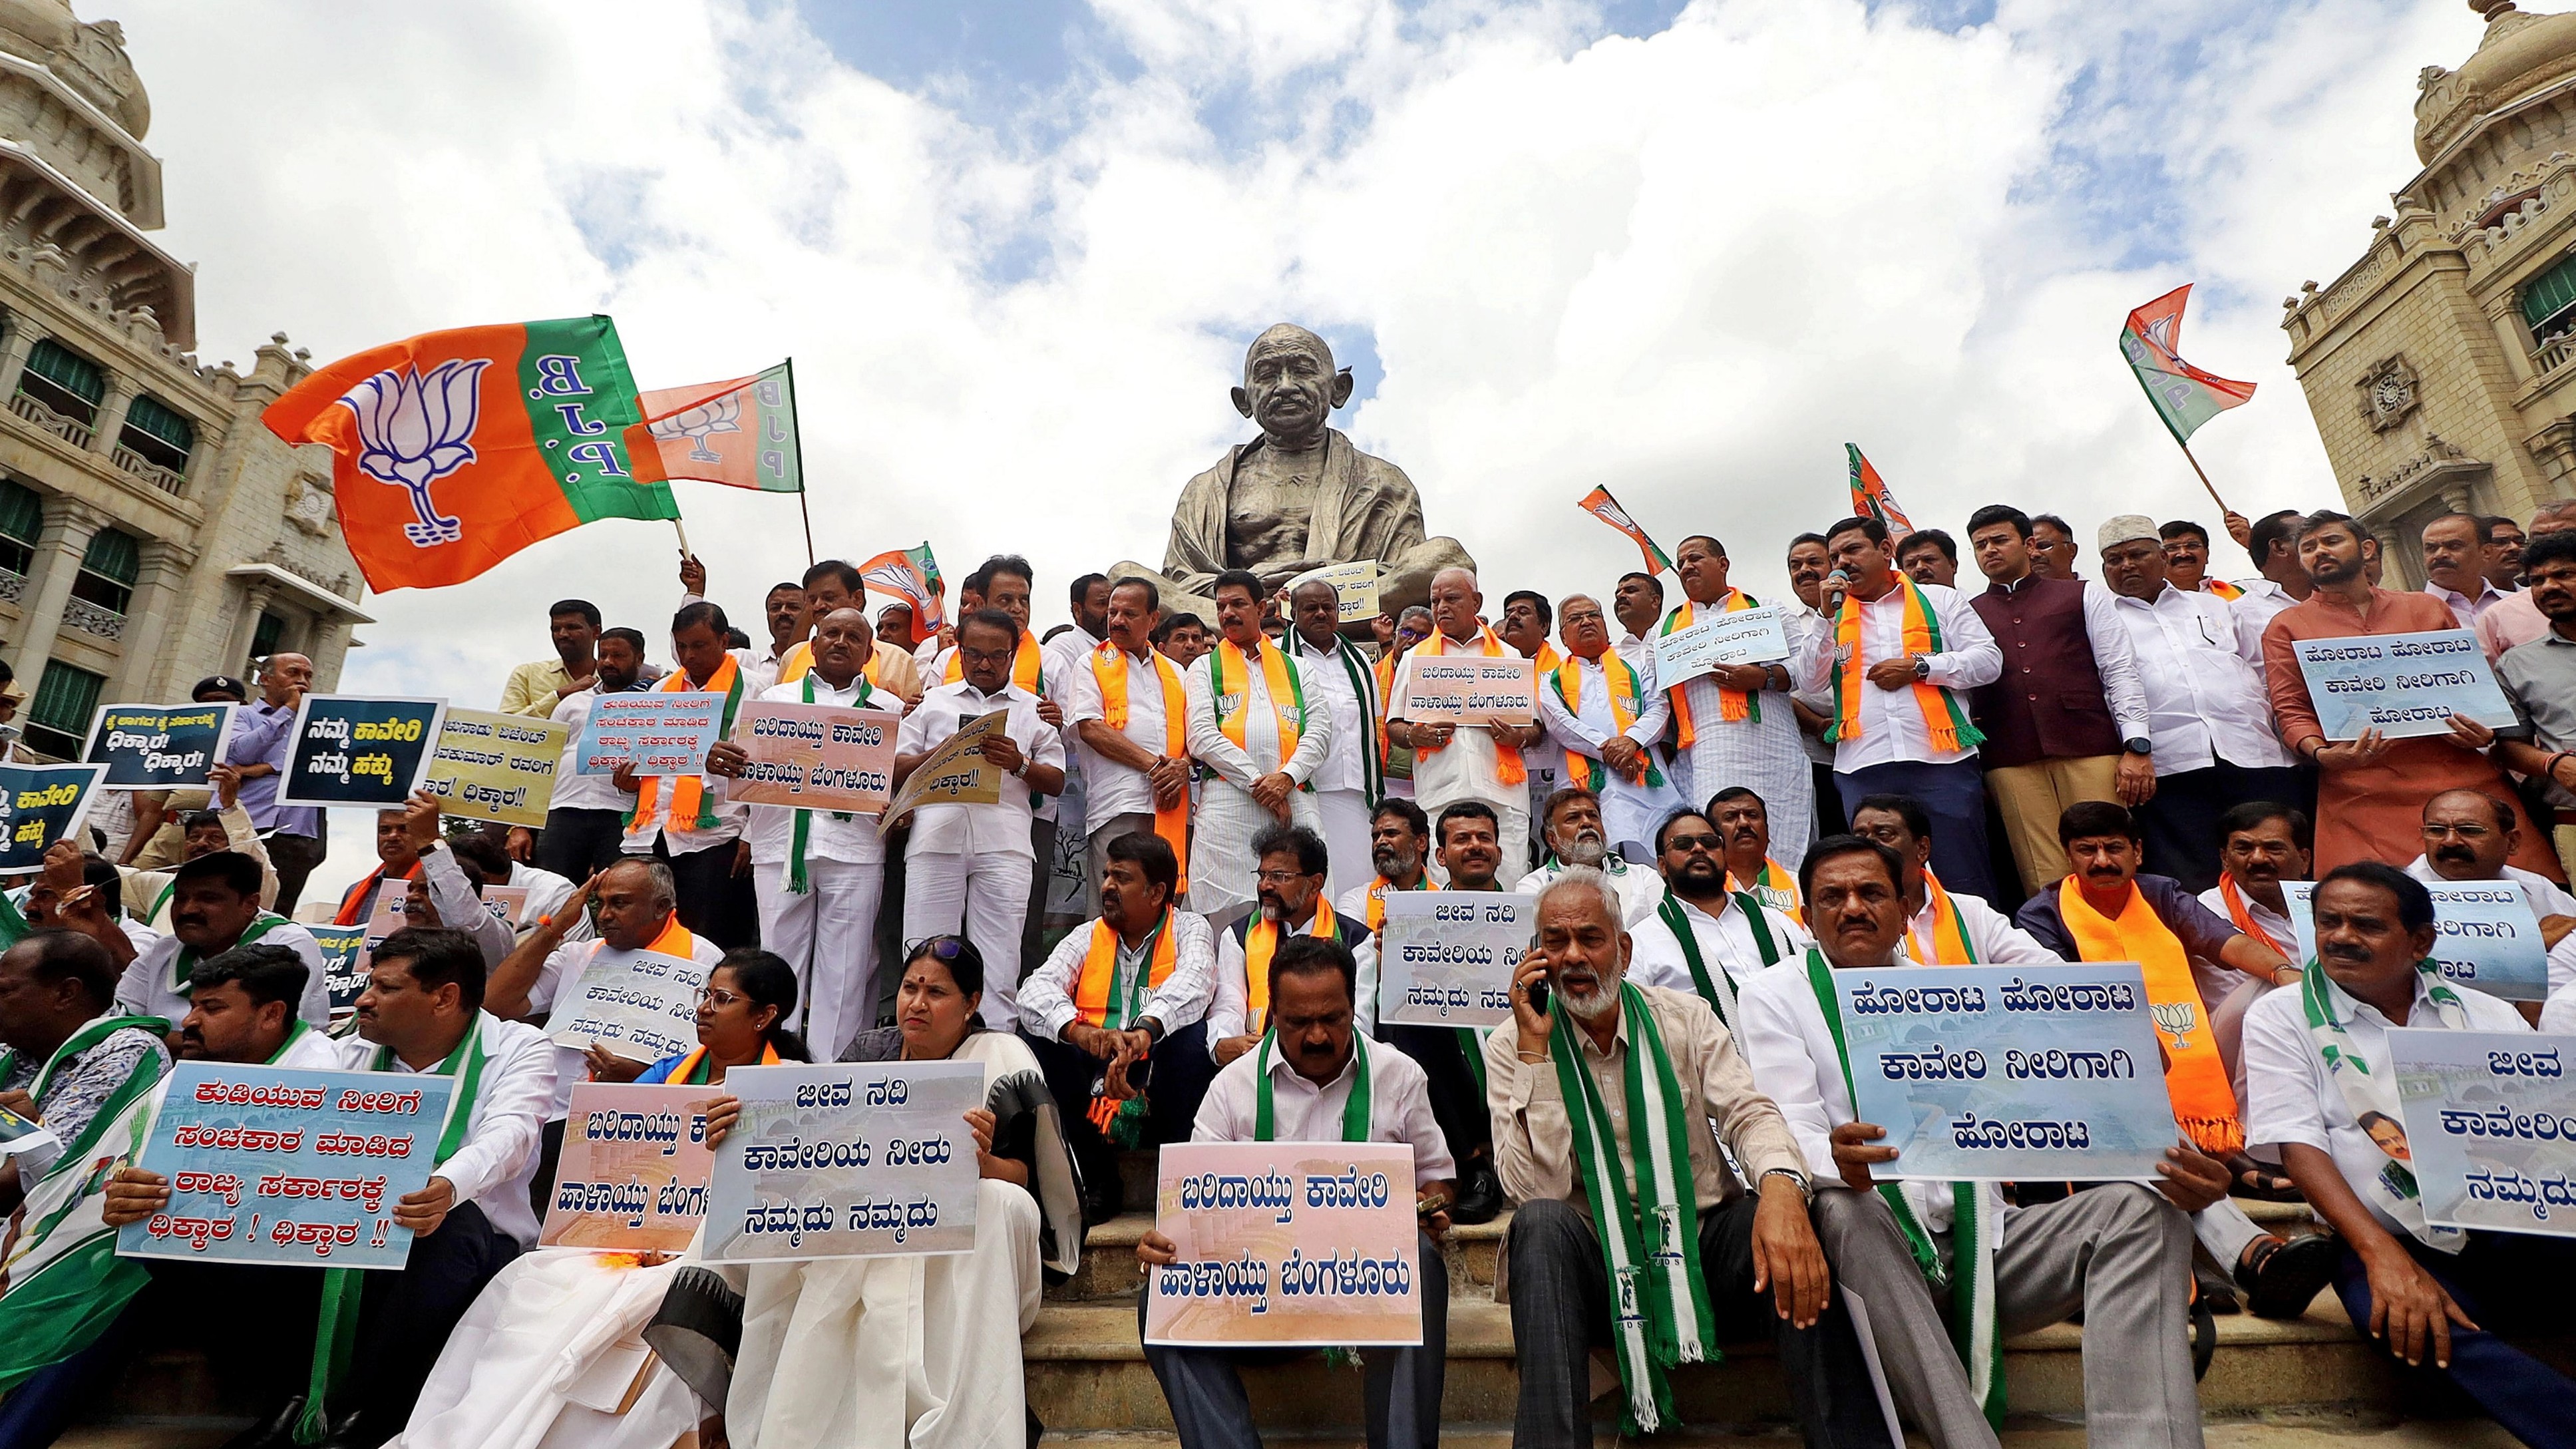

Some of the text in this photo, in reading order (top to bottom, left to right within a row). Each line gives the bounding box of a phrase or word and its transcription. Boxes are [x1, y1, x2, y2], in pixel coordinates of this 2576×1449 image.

[1339, 598, 1365, 616] ಕ್ಕಾರ!!
[1660, 610, 1773, 650] ಹೋರಾಟ ಹೋರಾಟ
[1666, 628, 1770, 662] ಕಾವೇರಿ ನೀರಿಗಾಗಿ
[2304, 637, 2473, 663] ಹೋರಾಟ ಹೋರಾಟ
[1421, 664, 1522, 684] ಬರಿದಾಯ್ತು ಕಾವೇರಿ
[2325, 668, 2477, 694] ಕಾವೇರಿ ನೀರಿಗಾಗಿ
[602, 698, 711, 710] ಕುಡಿಯುವ ನೀರಿಗೆ
[1410, 692, 1529, 716] ಹಾಳಾಯ್ತು ಬೆಂಗಳೂರು
[2370, 706, 2453, 725] ಹೋರಾಟ
[307, 717, 423, 749] ನಮ್ಮ ಕಾವೇರಿ
[498, 726, 548, 744] ಏಜೆಂಟ್
[595, 716, 710, 727] ಸಂಚಕಾರ ಮಾಡಿದ
[754, 716, 883, 749] ಬರಿದಾಯ್ತು ಕಾವೇರಿ
[105, 731, 171, 756] ಧಿಕ್ಕಾರ!
[598, 735, 699, 751] ರಾಜ್ಯ ಸರ್ಕಾರಕ್ಕೆ
[143, 750, 206, 775] ಧಿಕ್ಕಾರ!
[307, 751, 393, 786] ನಮ್ಮ ಹಕ್ಕು
[510, 756, 554, 775] ರವರಿಗೆ
[647, 755, 689, 772] ಧಿಕ್ಕಾರ
[811, 762, 888, 792] ಬೆಂಗಳೂರು
[16, 783, 79, 809] ಕಾವೇರಿ
[462, 782, 527, 813] ಧಿಕ್ಕಾರ!!
[15, 819, 46, 849] ಹಕ್ಕು
[1435, 900, 1516, 923] ಜೀವ ನದಿ
[1401, 940, 1493, 965] ಕಾವೇರಿಯ
[632, 959, 703, 988] ಜೀವ ನದಿ
[586, 985, 664, 1012] ಕಾವೇರಿಯ
[1406, 981, 1471, 1017] ನಮ್ಮದು
[1850, 976, 2137, 1014] ಹೋರಾಟ ಹೋರಾಟ
[567, 1016, 689, 1060] ನಮ್ಮದು ನಮ್ಮದು
[1879, 1043, 2136, 1081] ಕಾವೇರಿ ನೀರಿಗಾಗಿ
[2487, 1044, 2564, 1078] ಜೀವ
[194, 1078, 424, 1115] ಕುಡಿಯುವ ನೀರಿಗೆ
[796, 1073, 909, 1108] ಜೀವ ನದಿ
[172, 1121, 415, 1158] ಸಂಚಕಾರ ಮಾಡಿದ
[586, 1103, 682, 1157] ಬರಿದಾಯ್ತು
[1950, 1112, 2090, 1150] ಹೋರಾಟ
[742, 1131, 952, 1171] ಕಾವೇರಿಯ ನೀರು
[174, 1169, 388, 1213] ರಾಜ್ಯ ಸರ್ಕಾರಕ್ಕೆ
[556, 1173, 649, 1229] ಹಾಳಾಯ್ತು
[1181, 1163, 1391, 1225] ಬರಿದಾಯ್ತು ಕಾವೇರಿ
[146, 1213, 237, 1251] ಧಿಕ್ಕಾರ
[270, 1218, 361, 1257] ಧಿಕ್ಕಾರ
[369, 1218, 391, 1247] !!
[743, 1193, 940, 1249] ನಮ್ಮದು ನಮ್ಮದು
[1159, 1246, 1412, 1316] ಹಾಳಾಯ್ತು ಬೆಂಗಳೂರು
